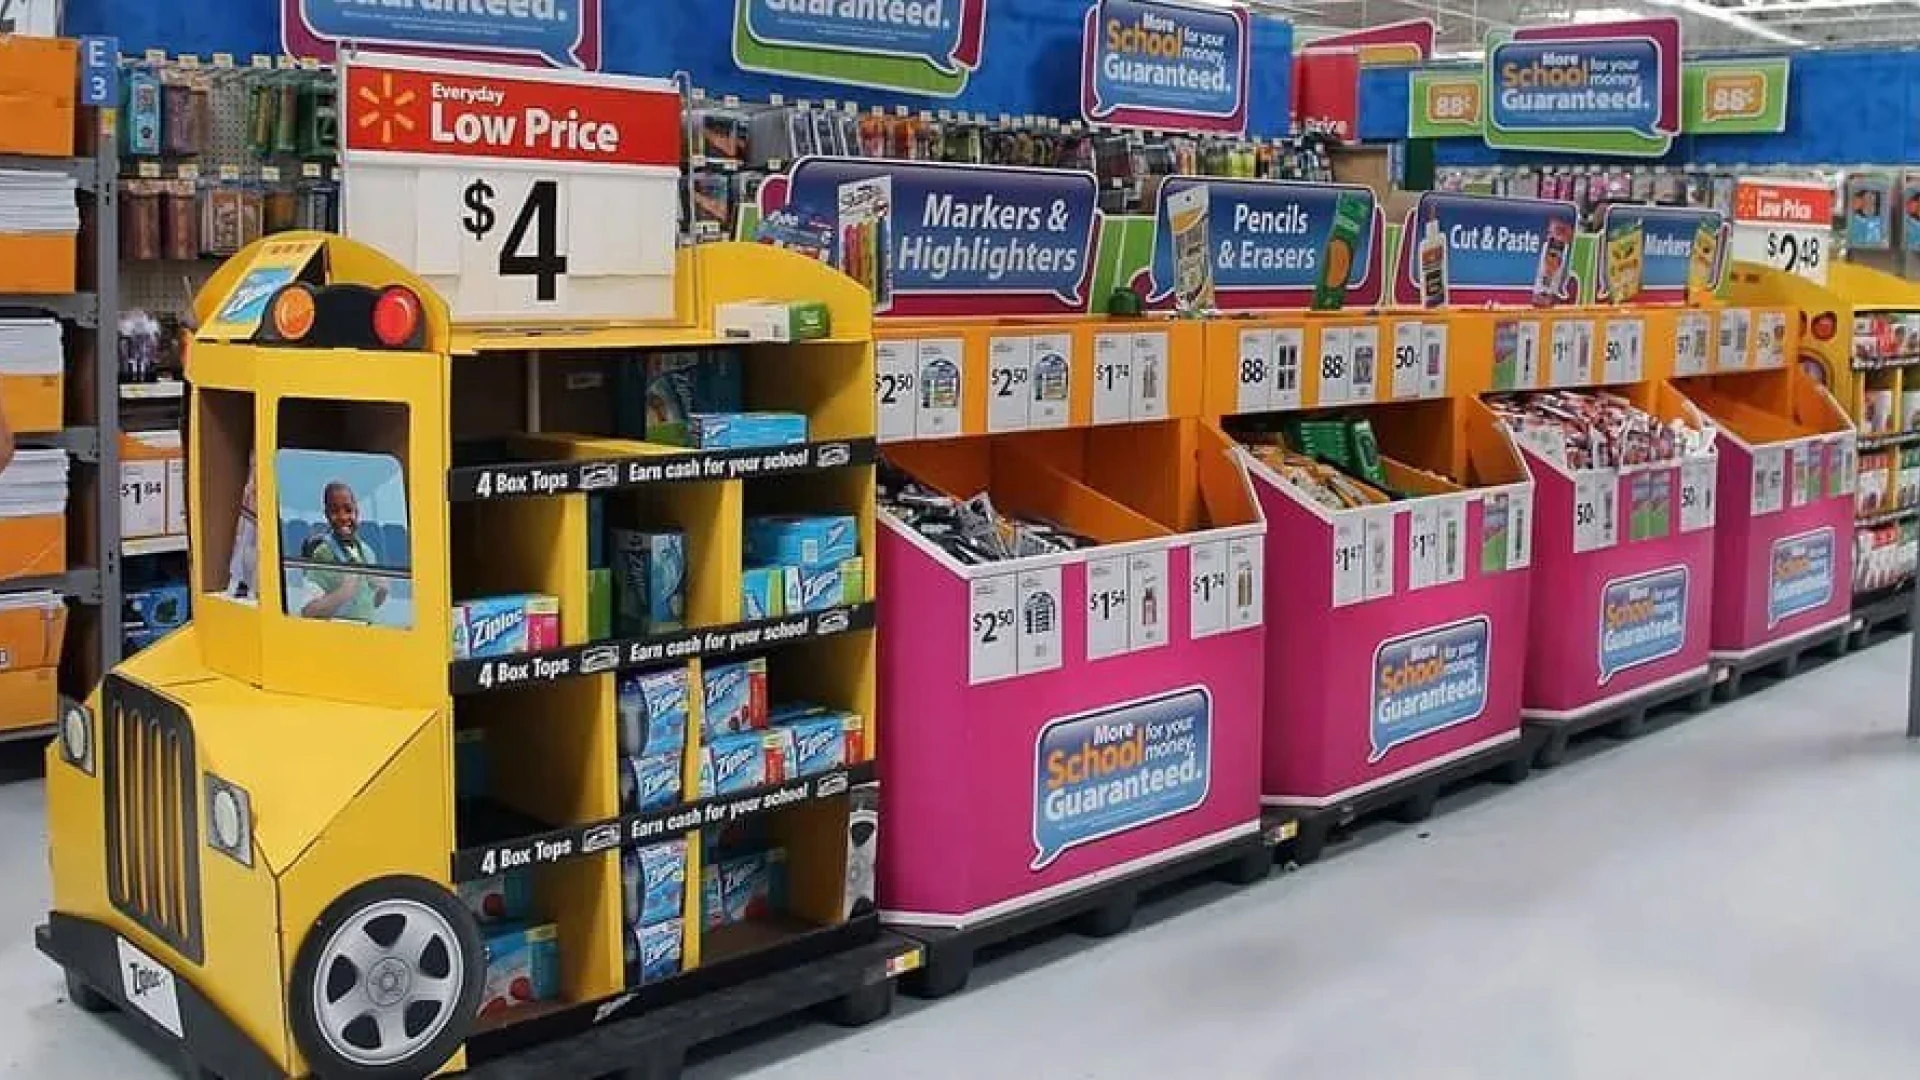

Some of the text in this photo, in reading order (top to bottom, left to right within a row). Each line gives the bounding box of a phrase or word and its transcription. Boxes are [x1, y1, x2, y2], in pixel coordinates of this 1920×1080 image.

[88, 40, 106, 67] E
[1106, 18, 1183, 59] School
[91, 76, 107, 100] 3
[1104, 53, 1232, 93] Guaranteed.
[1503, 59, 1587, 87] School
[431, 82, 503, 106] Everyday
[1502, 86, 1650, 111] Guaranteed.
[431, 101, 620, 152] Low Price
[922, 193, 1041, 231] Markers
[1047, 198, 1070, 233] &
[1233, 202, 1309, 234] Pencils
[462, 178, 568, 301] $4
[1217, 239, 1316, 271] & Erasers
[1449, 223, 1540, 253] Cut & Paste
[899, 234, 1078, 280] Highlighters
[476, 472, 491, 497] 4
[497, 472, 527, 494] Box
[532, 470, 568, 495] Tops
[629, 461, 662, 483] Earn
[665, 456, 700, 480] cash
[704, 455, 724, 476] for
[728, 454, 761, 478] your
[763, 449, 808, 470] school
[630, 641, 662, 662] Earn
[666, 634, 701, 659] cash
[704, 632, 726, 652] for
[730, 628, 761, 652] your
[763, 618, 808, 641] school
[478, 662, 492, 687] 4
[498, 662, 528, 682] Box
[533, 657, 570, 682] Tops
[1382, 648, 1444, 694] School
[1094, 722, 1134, 746] More
[1047, 716, 1194, 790] School for your
[1044, 752, 1203, 822] Guaranteed.
[631, 819, 664, 840] Earn
[667, 806, 701, 831] cash
[704, 804, 726, 822] for
[730, 796, 761, 820] your
[763, 783, 808, 809] school
[481, 849, 496, 876] 4
[500, 847, 531, 869] Box
[534, 838, 572, 864] Tops
